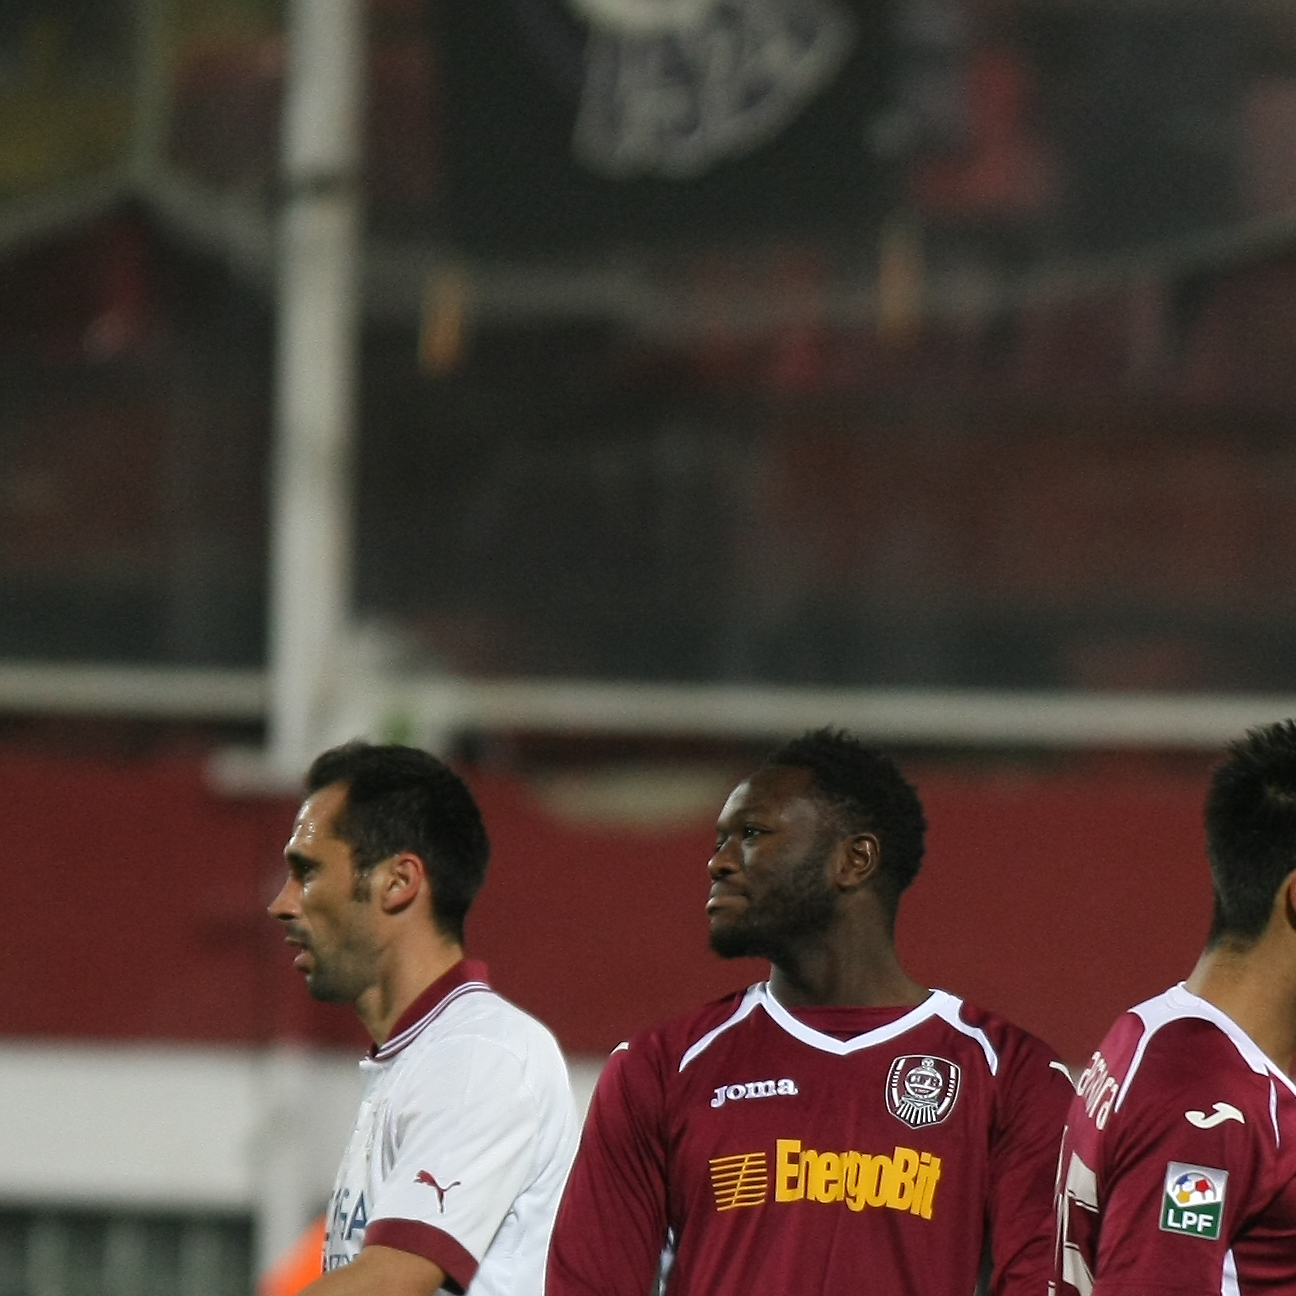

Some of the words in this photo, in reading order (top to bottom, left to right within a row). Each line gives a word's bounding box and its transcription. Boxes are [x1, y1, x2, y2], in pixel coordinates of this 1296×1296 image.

[710, 1076, 799, 1108] Joma
[775, 1138, 942, 1220] EnergoBit
[1167, 1208, 1214, 1232] LPF
